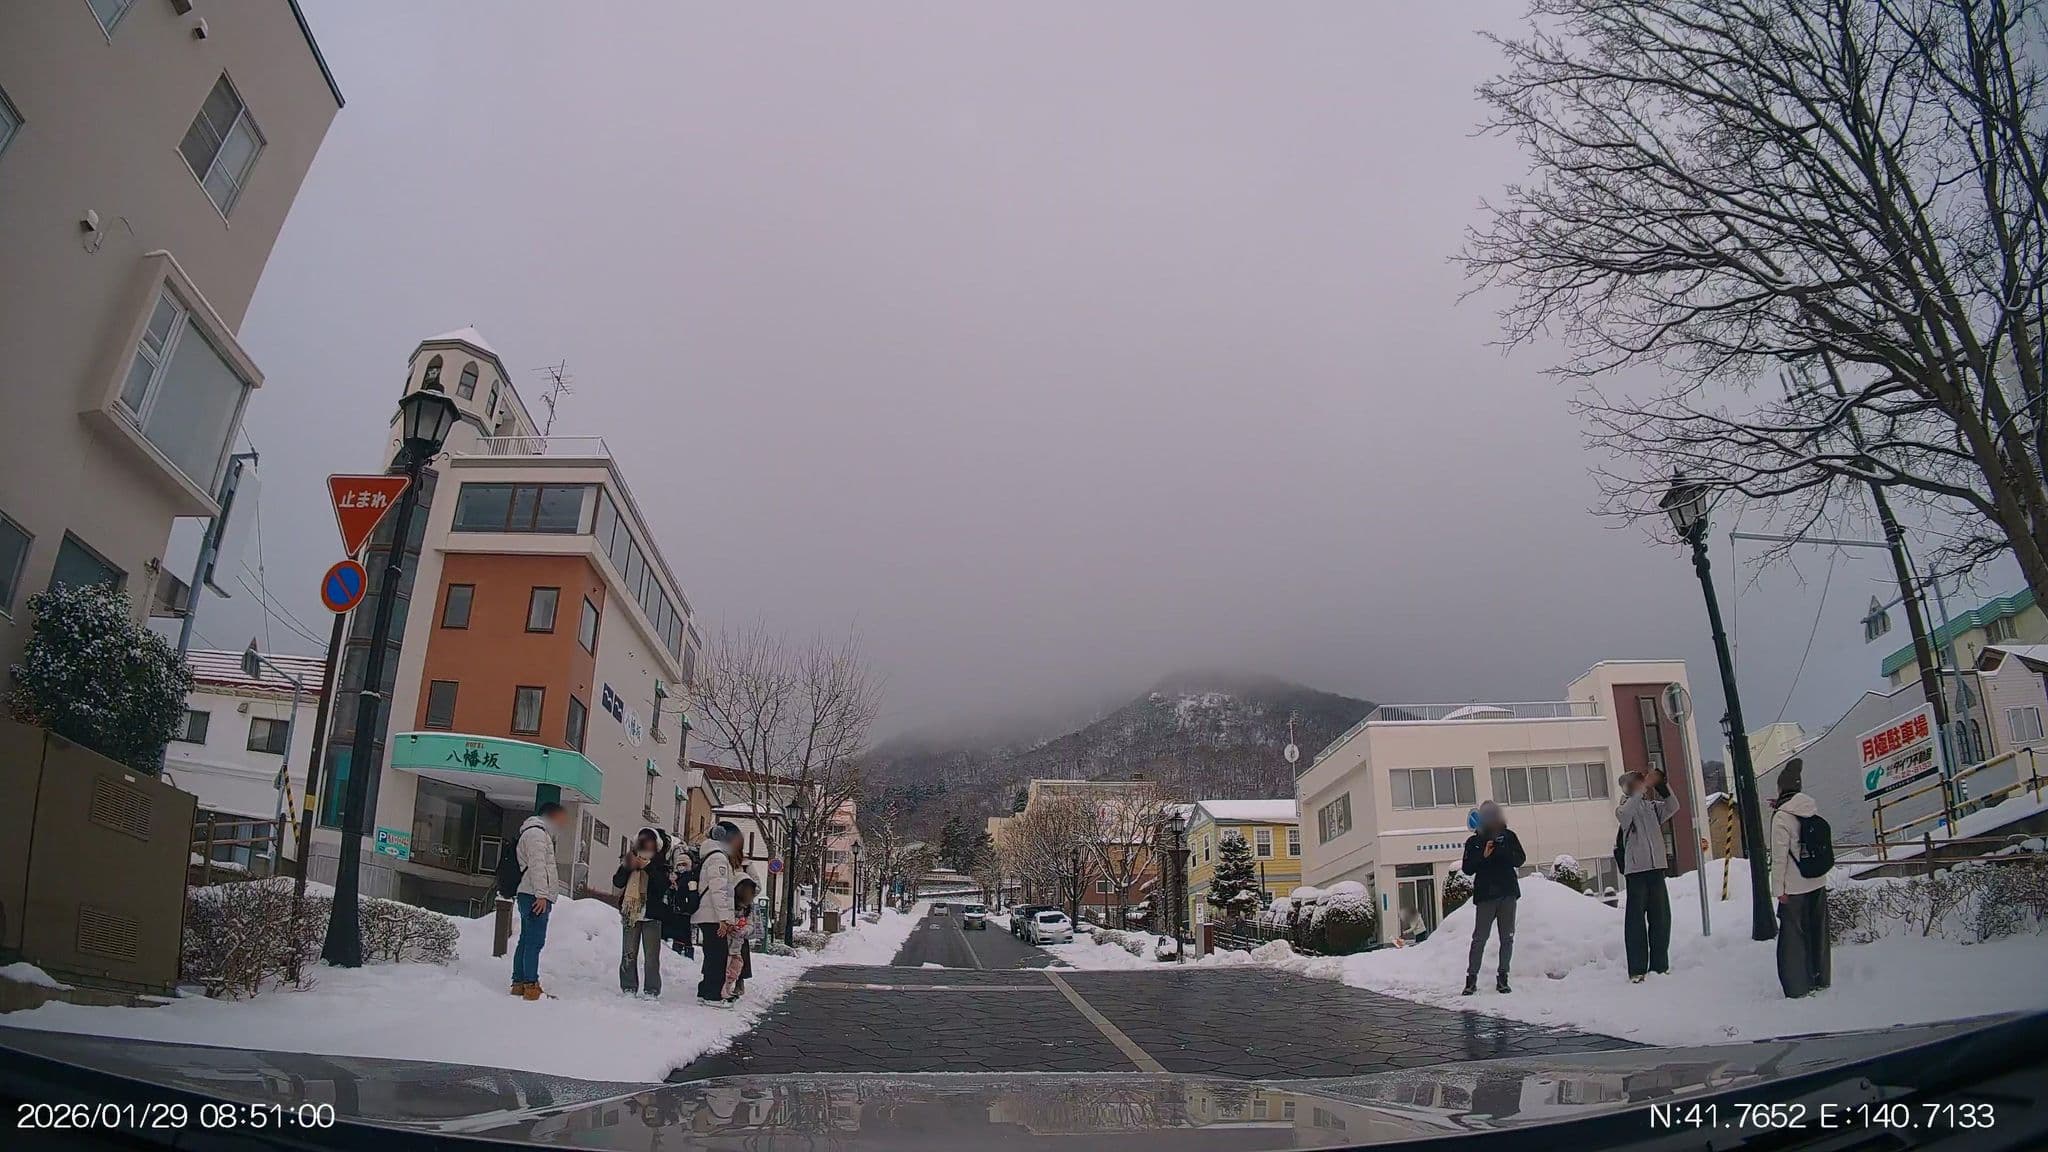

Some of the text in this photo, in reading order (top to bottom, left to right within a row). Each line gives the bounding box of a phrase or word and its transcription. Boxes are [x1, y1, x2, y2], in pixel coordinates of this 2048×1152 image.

[338, 489, 388, 509] 止まれ
[1862, 713, 1929, 763] 月極駐車場
[446, 749, 501, 769] 八幡坂
